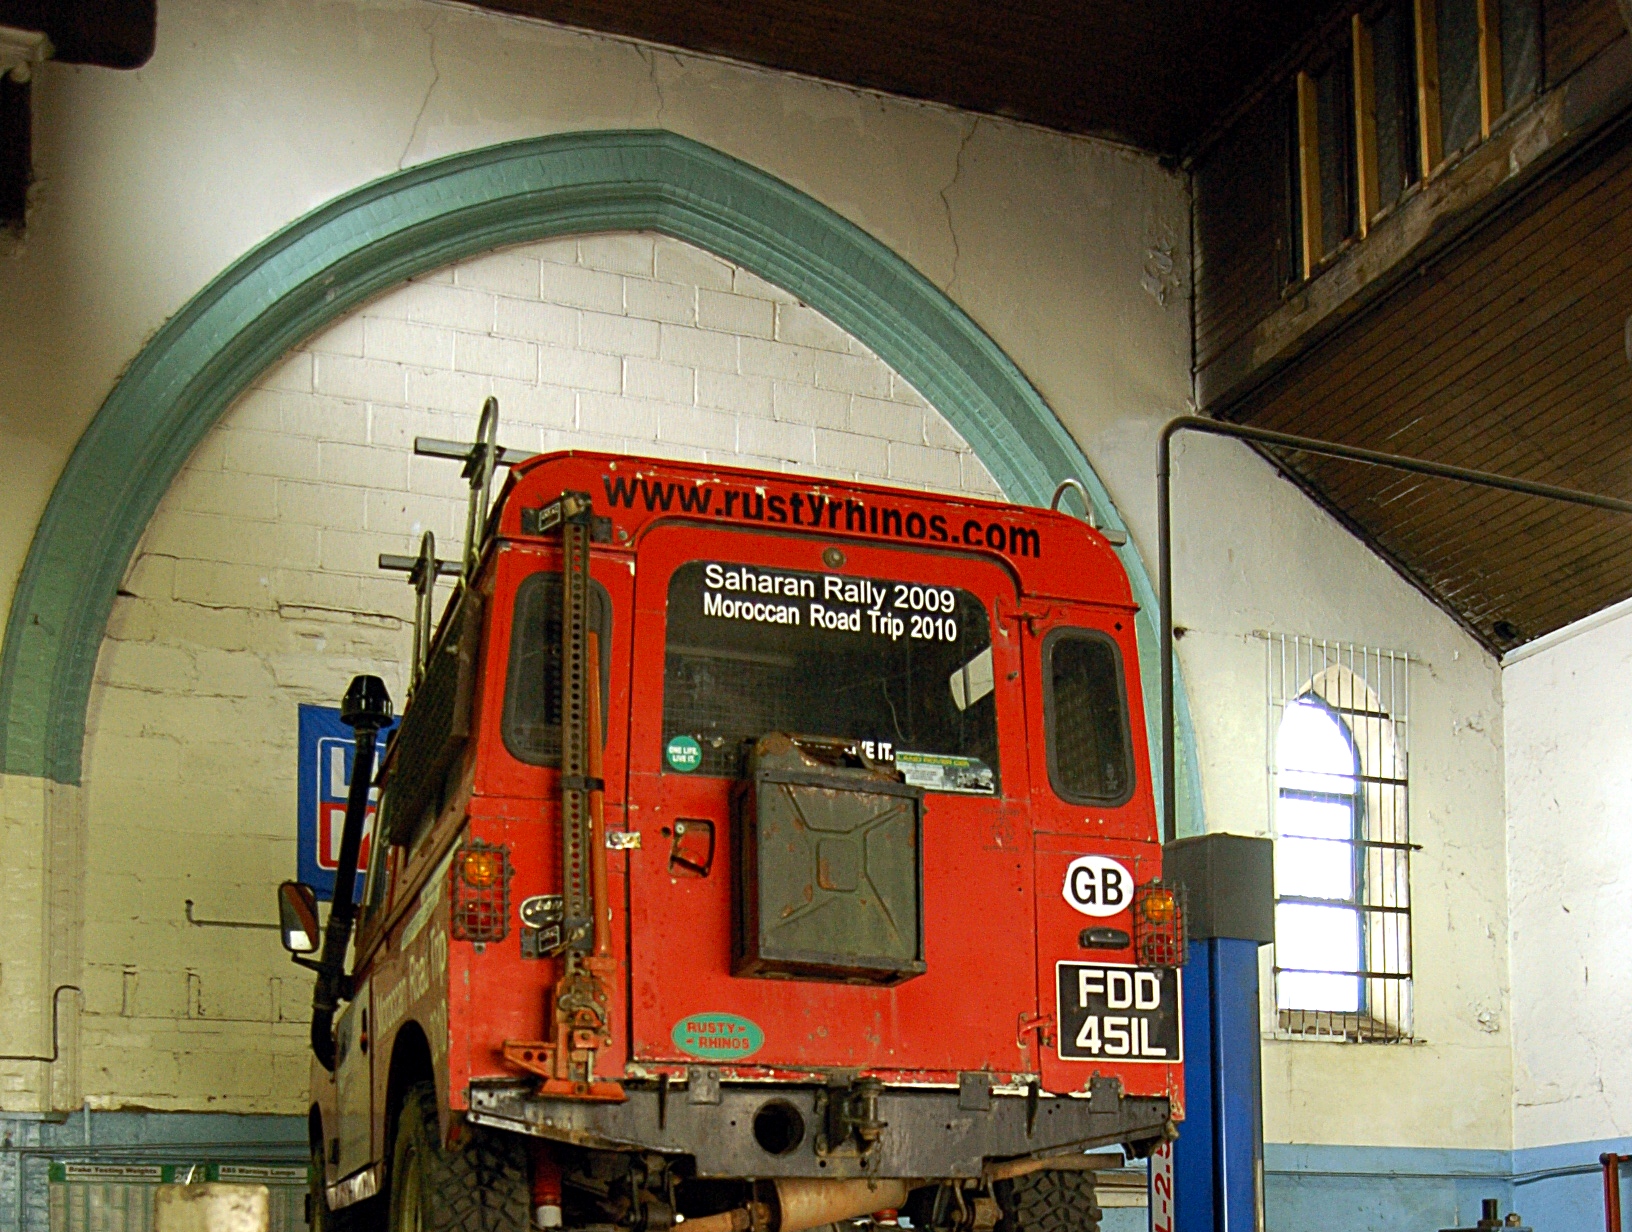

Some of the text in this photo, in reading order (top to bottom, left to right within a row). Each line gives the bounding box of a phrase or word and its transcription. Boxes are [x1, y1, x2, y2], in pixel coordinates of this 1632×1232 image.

[602, 474, 1041, 558] www.rustyrhinos.com
[705, 564, 955, 613] Saharan Rally 2009
[703, 592, 957, 641] Moroccan Road Trip 2010
[1070, 866, 1124, 905] GB
[1078, 969, 1161, 1010] FDD
[686, 1022, 735, 1034] RUSTY
[698, 1036, 750, 1050] RHINOS
